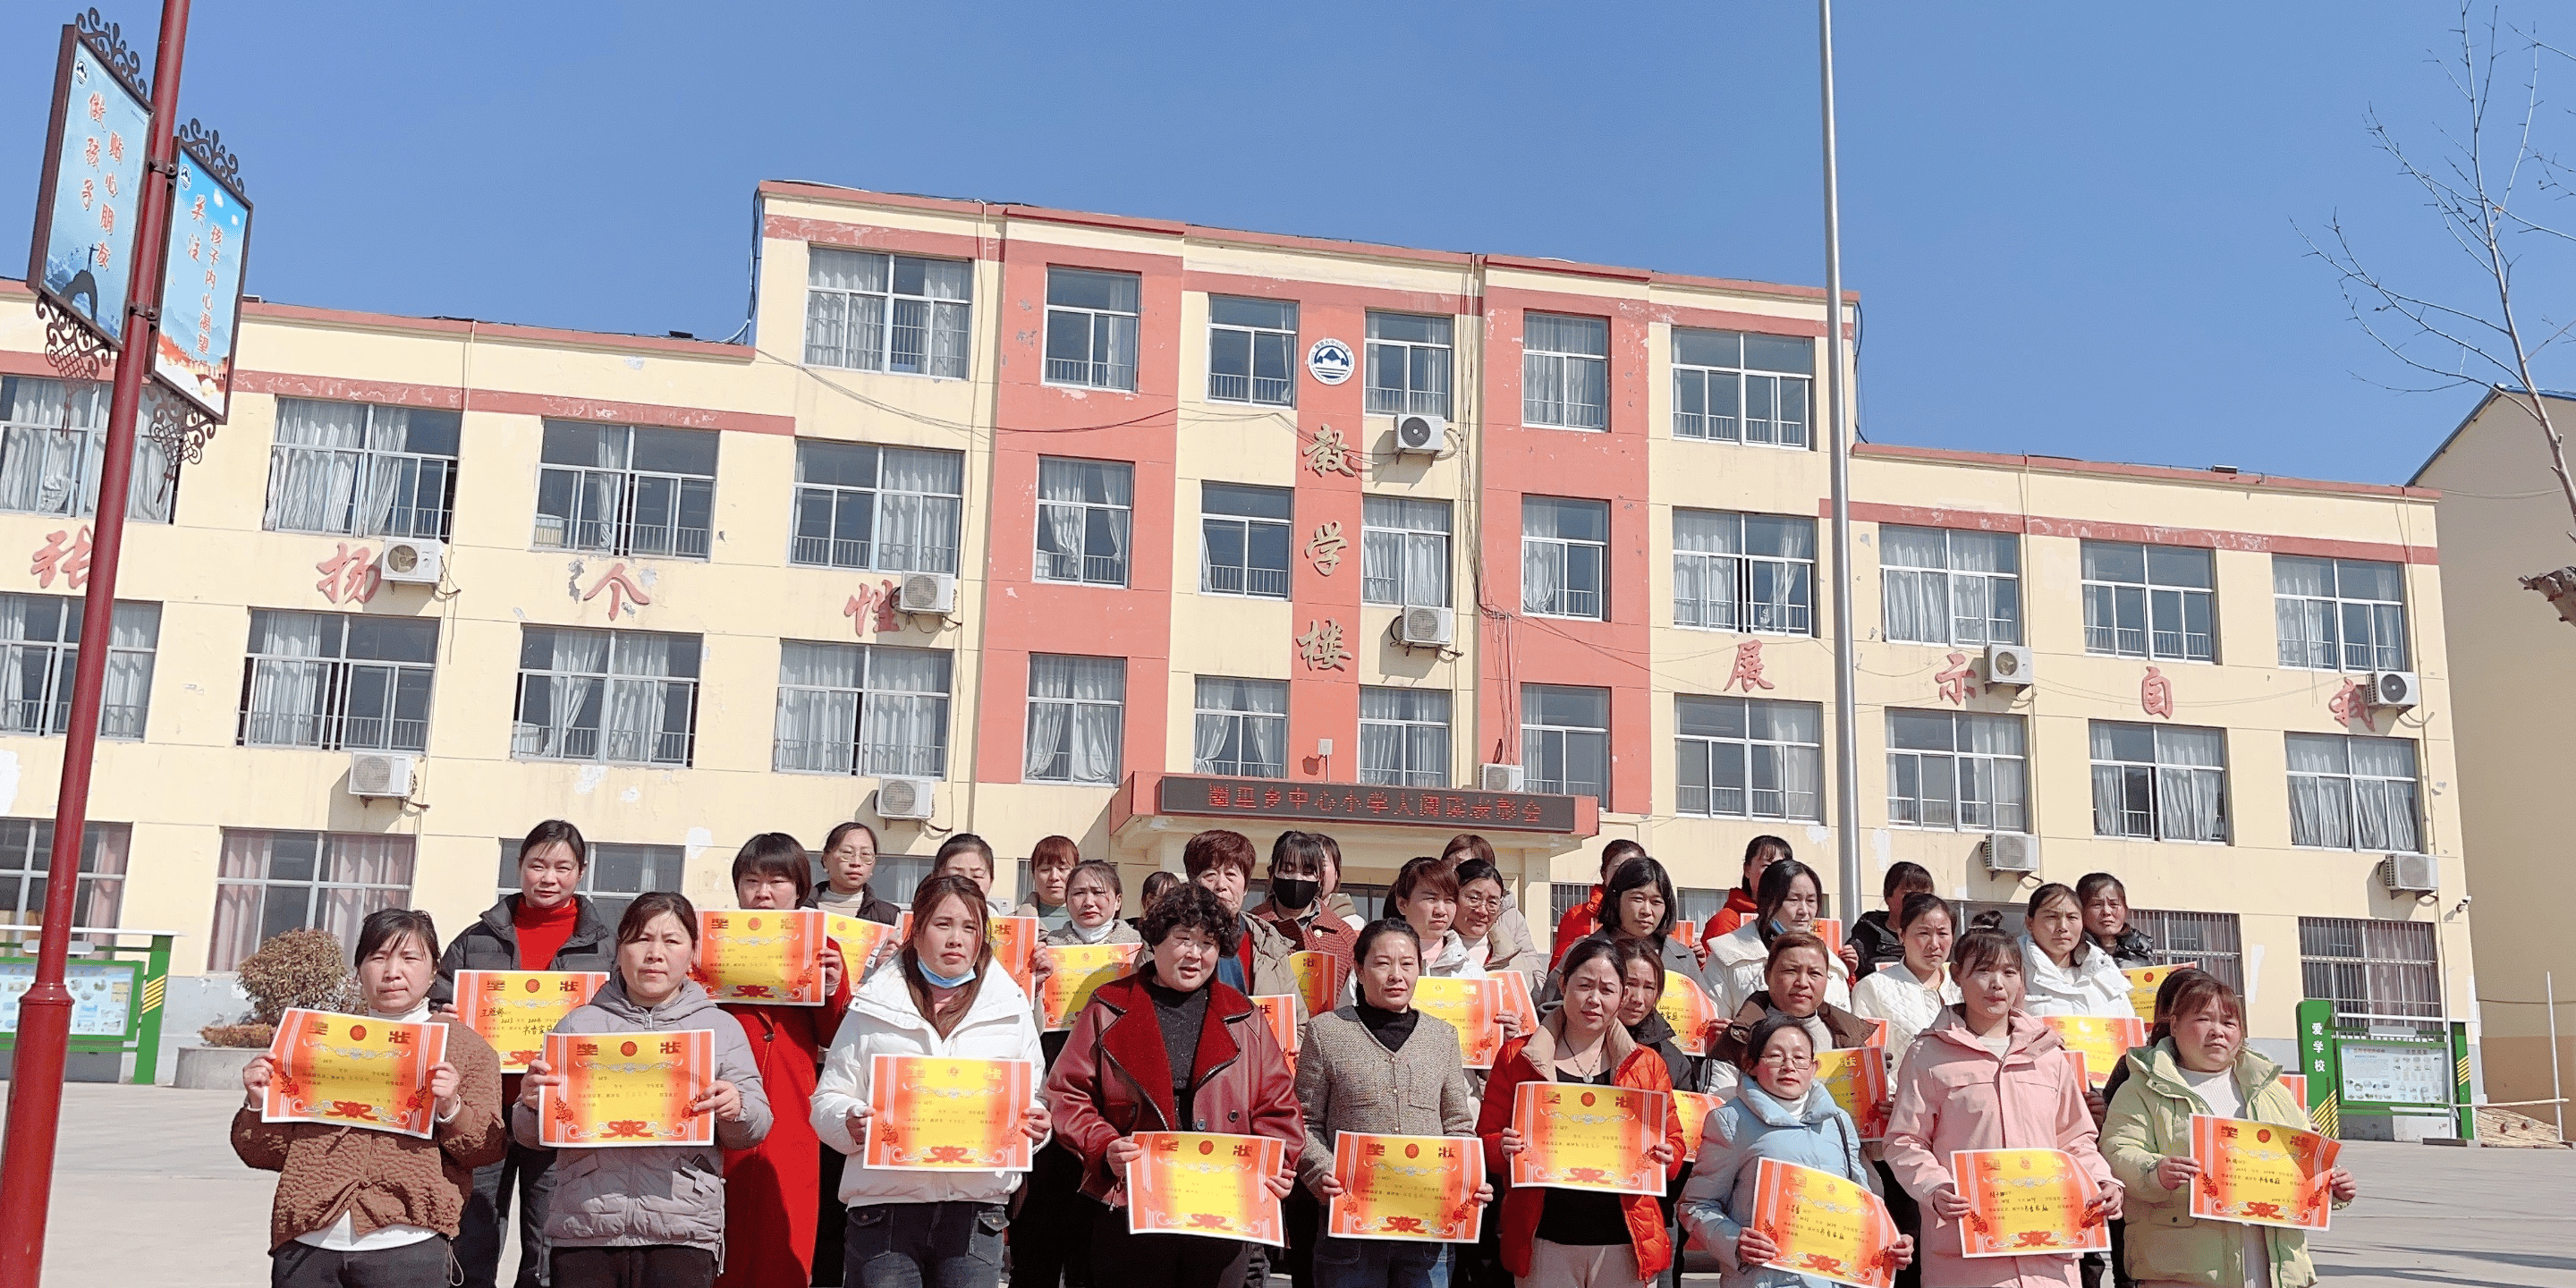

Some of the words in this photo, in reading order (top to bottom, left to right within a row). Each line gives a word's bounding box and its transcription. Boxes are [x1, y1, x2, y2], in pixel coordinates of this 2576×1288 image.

[80, 91, 106, 212] 做孩子
[97, 131, 124, 271] 贴心朋友
[186, 198, 208, 264] 关注
[197, 225, 224, 357] 孩子内心渴望
[1295, 423, 1356, 672] 教学楼
[2311, 1022, 2326, 1073] 爱学校
